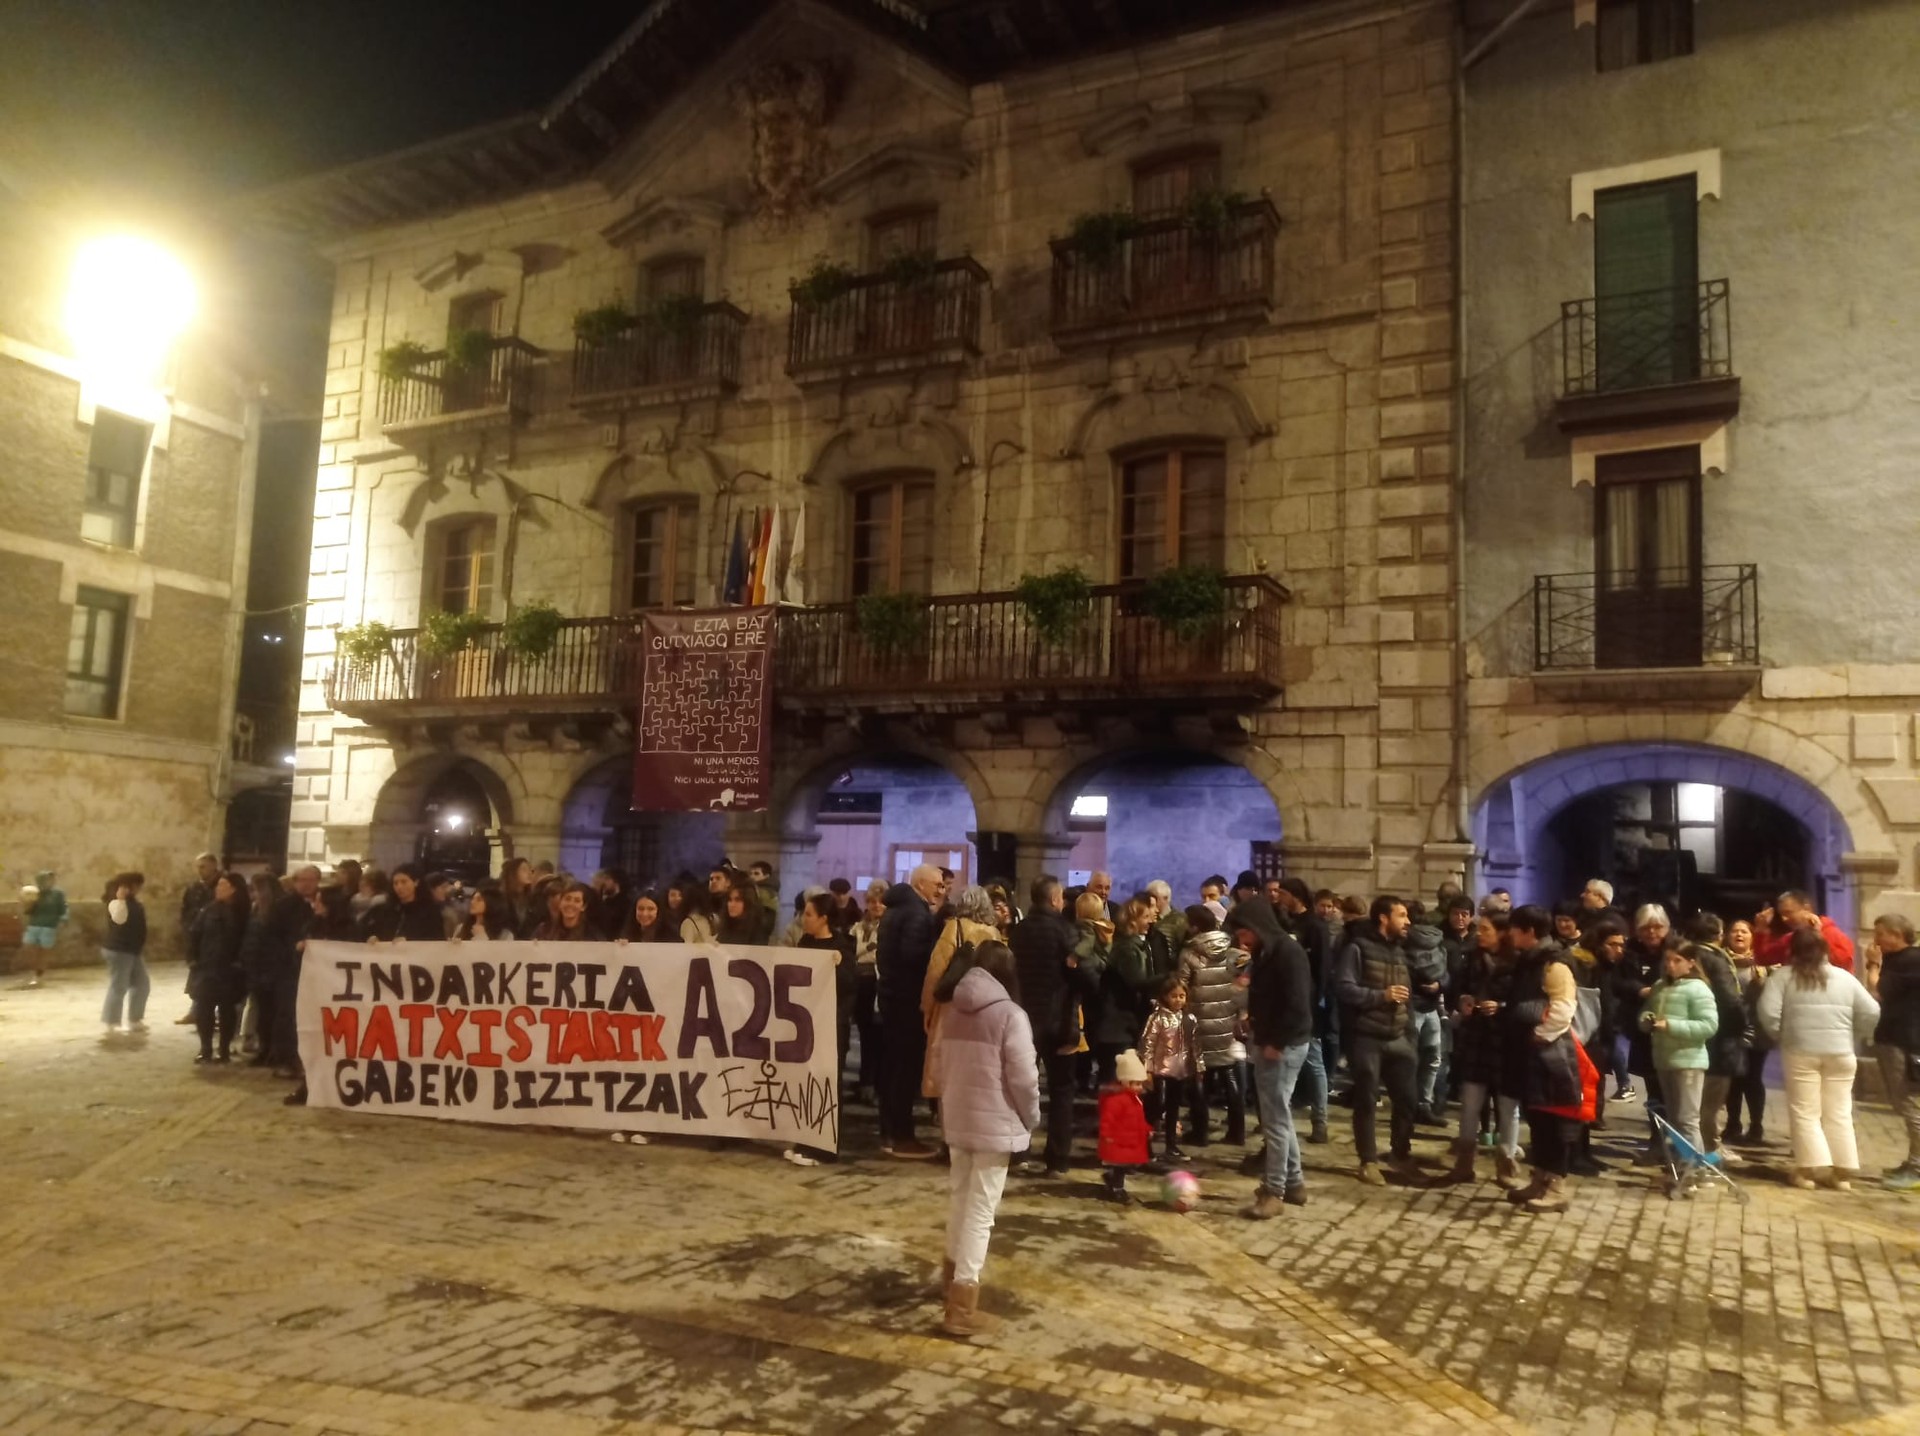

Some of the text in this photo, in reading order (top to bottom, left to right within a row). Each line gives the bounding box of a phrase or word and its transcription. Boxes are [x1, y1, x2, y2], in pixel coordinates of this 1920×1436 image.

[652, 631, 766, 649] GUTXIAGO ERE
[694, 616, 768, 632] EZTA BAT
[694, 756, 760, 765] NI UNA MENOS
[332, 961, 655, 1012] INDARKERIA
[677, 957, 815, 1063] A25
[321, 1004, 668, 1067] MATXISTARIK
[334, 1059, 708, 1120] GABEKO BIZITZAK
